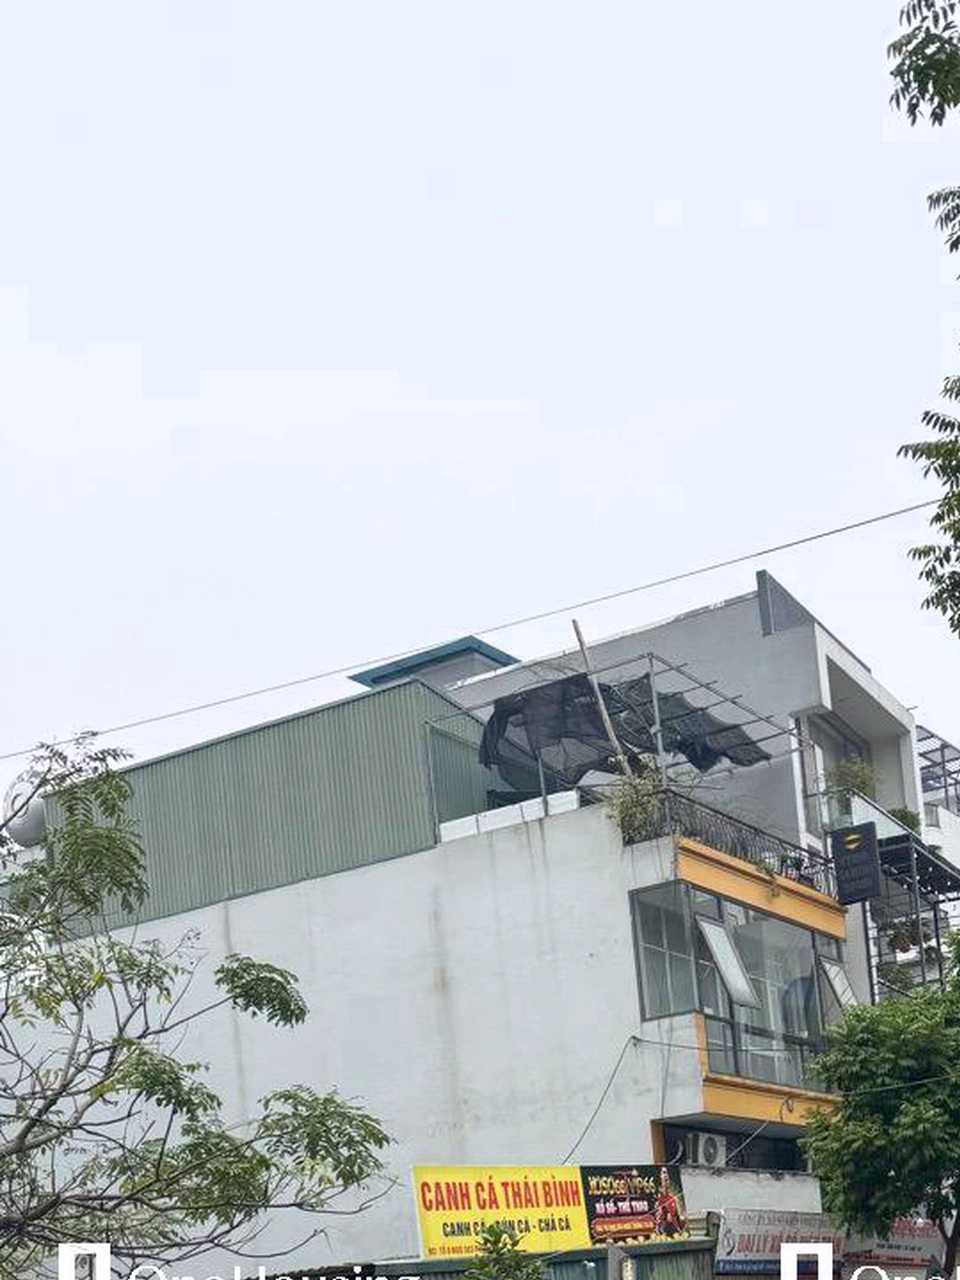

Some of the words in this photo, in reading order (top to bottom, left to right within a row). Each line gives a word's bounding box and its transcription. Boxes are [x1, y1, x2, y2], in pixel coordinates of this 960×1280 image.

[421, 1181, 471, 1211] CANH
[475, 1175, 500, 1210] CÁ
[501, 1176, 540, 1209] THÁI
[543, 1174, 582, 1207] BÌNH
[443, 1221, 471, 1237] CANH
